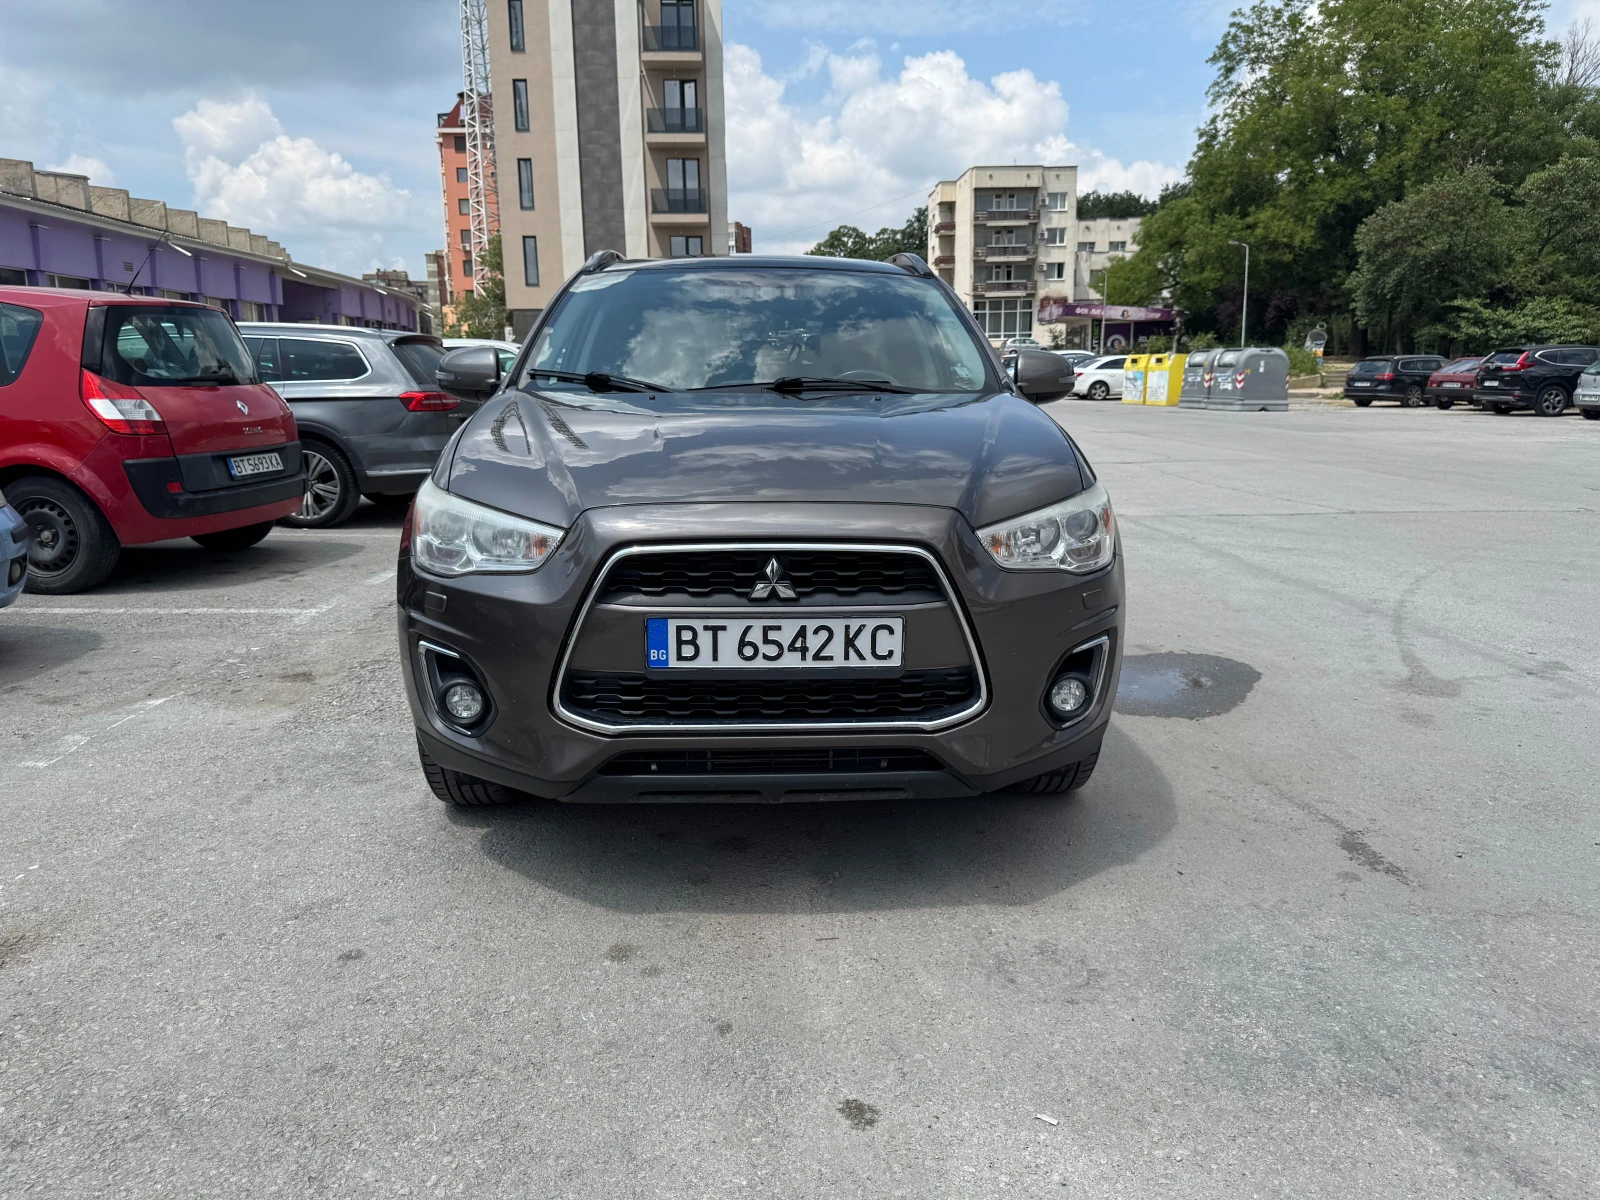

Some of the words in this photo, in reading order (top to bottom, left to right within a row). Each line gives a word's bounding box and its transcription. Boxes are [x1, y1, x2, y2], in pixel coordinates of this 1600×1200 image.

[233, 459, 248, 474] BT
[247, 456, 270, 471] 5693
[268, 454, 282, 469] KA
[675, 624, 727, 661] BT
[737, 624, 834, 661] 6542
[843, 623, 895, 661] KC
[650, 649, 667, 661] BG
